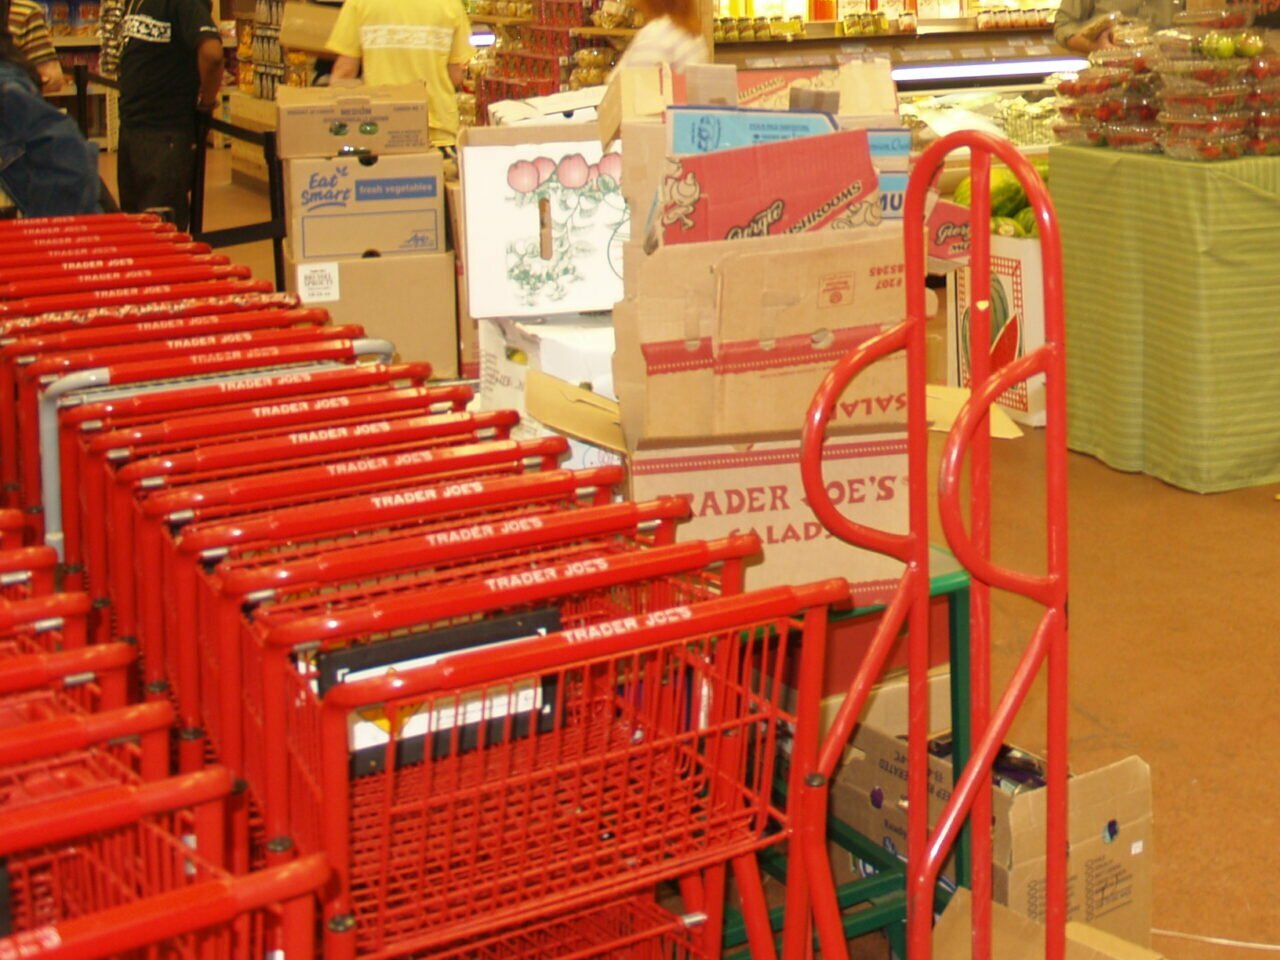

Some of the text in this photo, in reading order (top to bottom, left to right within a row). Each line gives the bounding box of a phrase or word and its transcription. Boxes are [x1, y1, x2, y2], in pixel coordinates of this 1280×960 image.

[309, 172, 339, 189] Eat
[359, 182, 434, 196] fresh vegetables
[301, 188, 352, 207] Smart
[783, 180, 862, 235] USHROOMS
[62, 257, 134, 270] TRADER JOE'S
[78, 272, 120, 282] TRADER
[94, 284, 171, 299] TRADER JOE'S
[137, 318, 184, 331] TRADER
[167, 332, 253, 349] TRADER JOE'S
[219, 373, 312, 392] TRADER JOE'S
[253, 396, 350, 418] TRADER JOE'S
[289, 421, 392, 444] TRADER JOE'S
[326, 450, 434, 476] TRADER JOE'S
[371, 480, 485, 509] TRADER JOE'S
[657, 473, 898, 518] RADER OE'S
[426, 516, 544, 547] TRADER JOE'S
[484, 557, 609, 592] TRADER JOE'S
[562, 617, 640, 644] TRADER
